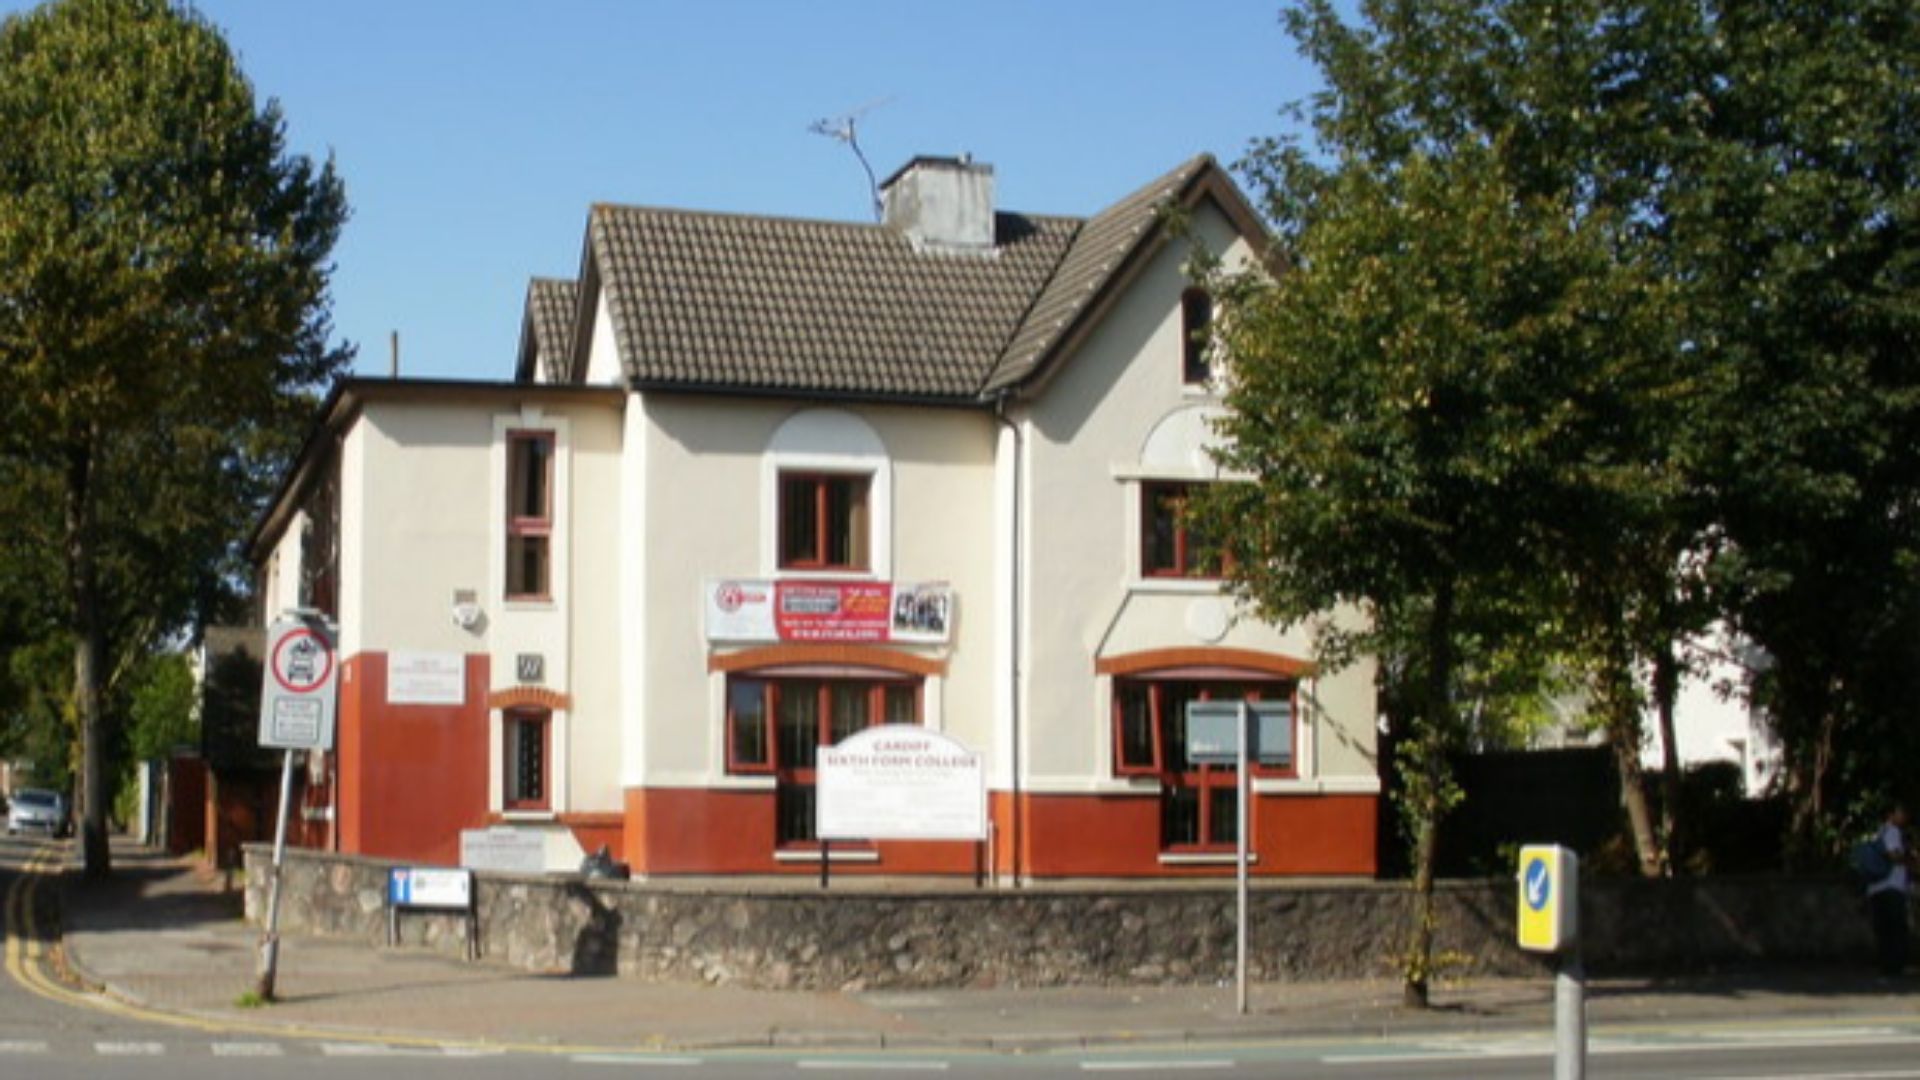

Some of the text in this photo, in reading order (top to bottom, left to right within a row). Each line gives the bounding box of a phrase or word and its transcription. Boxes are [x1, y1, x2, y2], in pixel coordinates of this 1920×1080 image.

[872, 739, 931, 751] CARDIFF
[827, 754, 977, 768] SIXTH FORM COLLEGE
